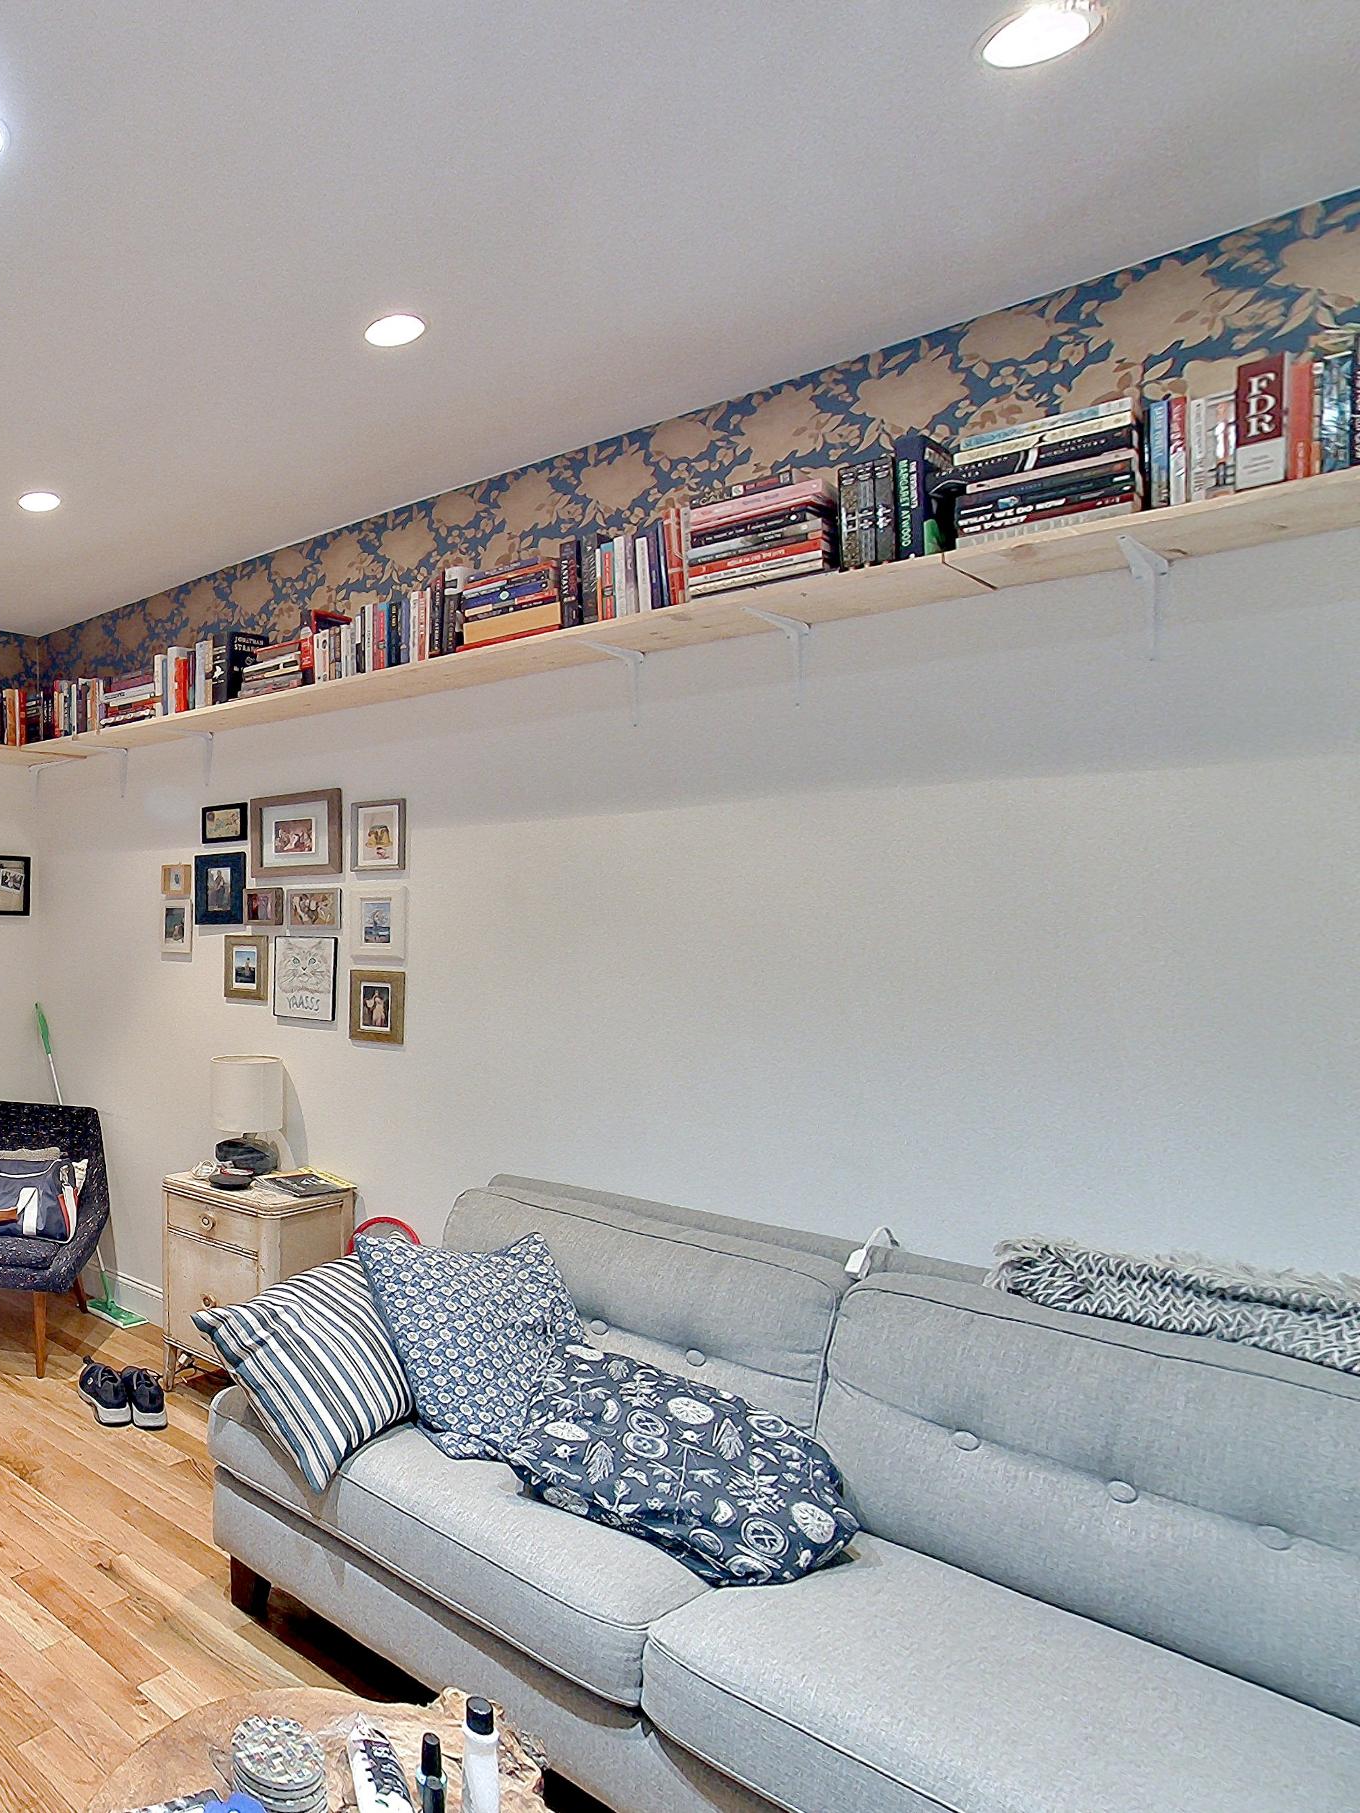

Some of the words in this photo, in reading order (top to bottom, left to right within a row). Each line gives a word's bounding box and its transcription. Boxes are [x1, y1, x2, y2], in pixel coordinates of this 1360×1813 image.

[1247, 372, 1277, 438] FDR
[899, 459, 910, 507] MARGARET
[901, 510, 912, 547] ATWOOD
[1016, 505, 1034, 515] DO
[287, 995, 320, 1011] YAASSS
